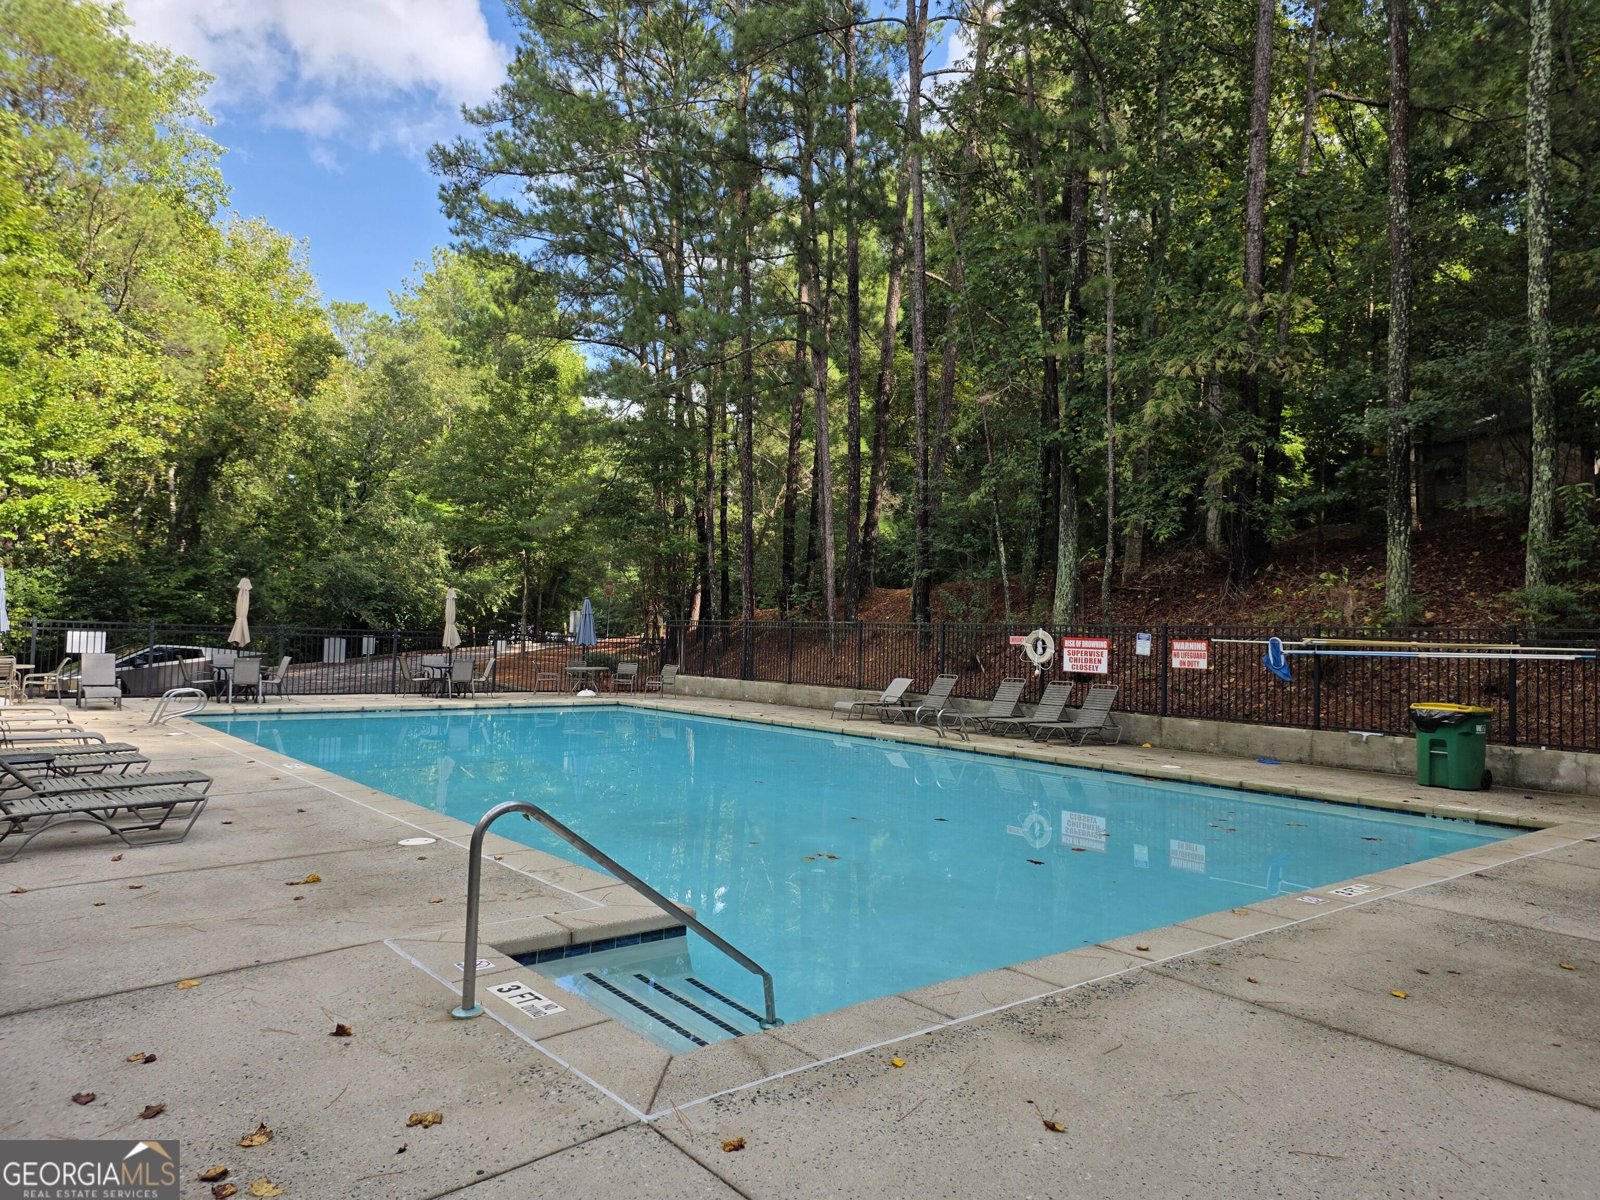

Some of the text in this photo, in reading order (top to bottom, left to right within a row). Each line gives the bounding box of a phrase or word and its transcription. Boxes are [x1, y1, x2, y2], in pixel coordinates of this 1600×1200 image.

[1173, 641, 1206, 650] WARNING
[496, 984, 542, 1004] 3 FT
